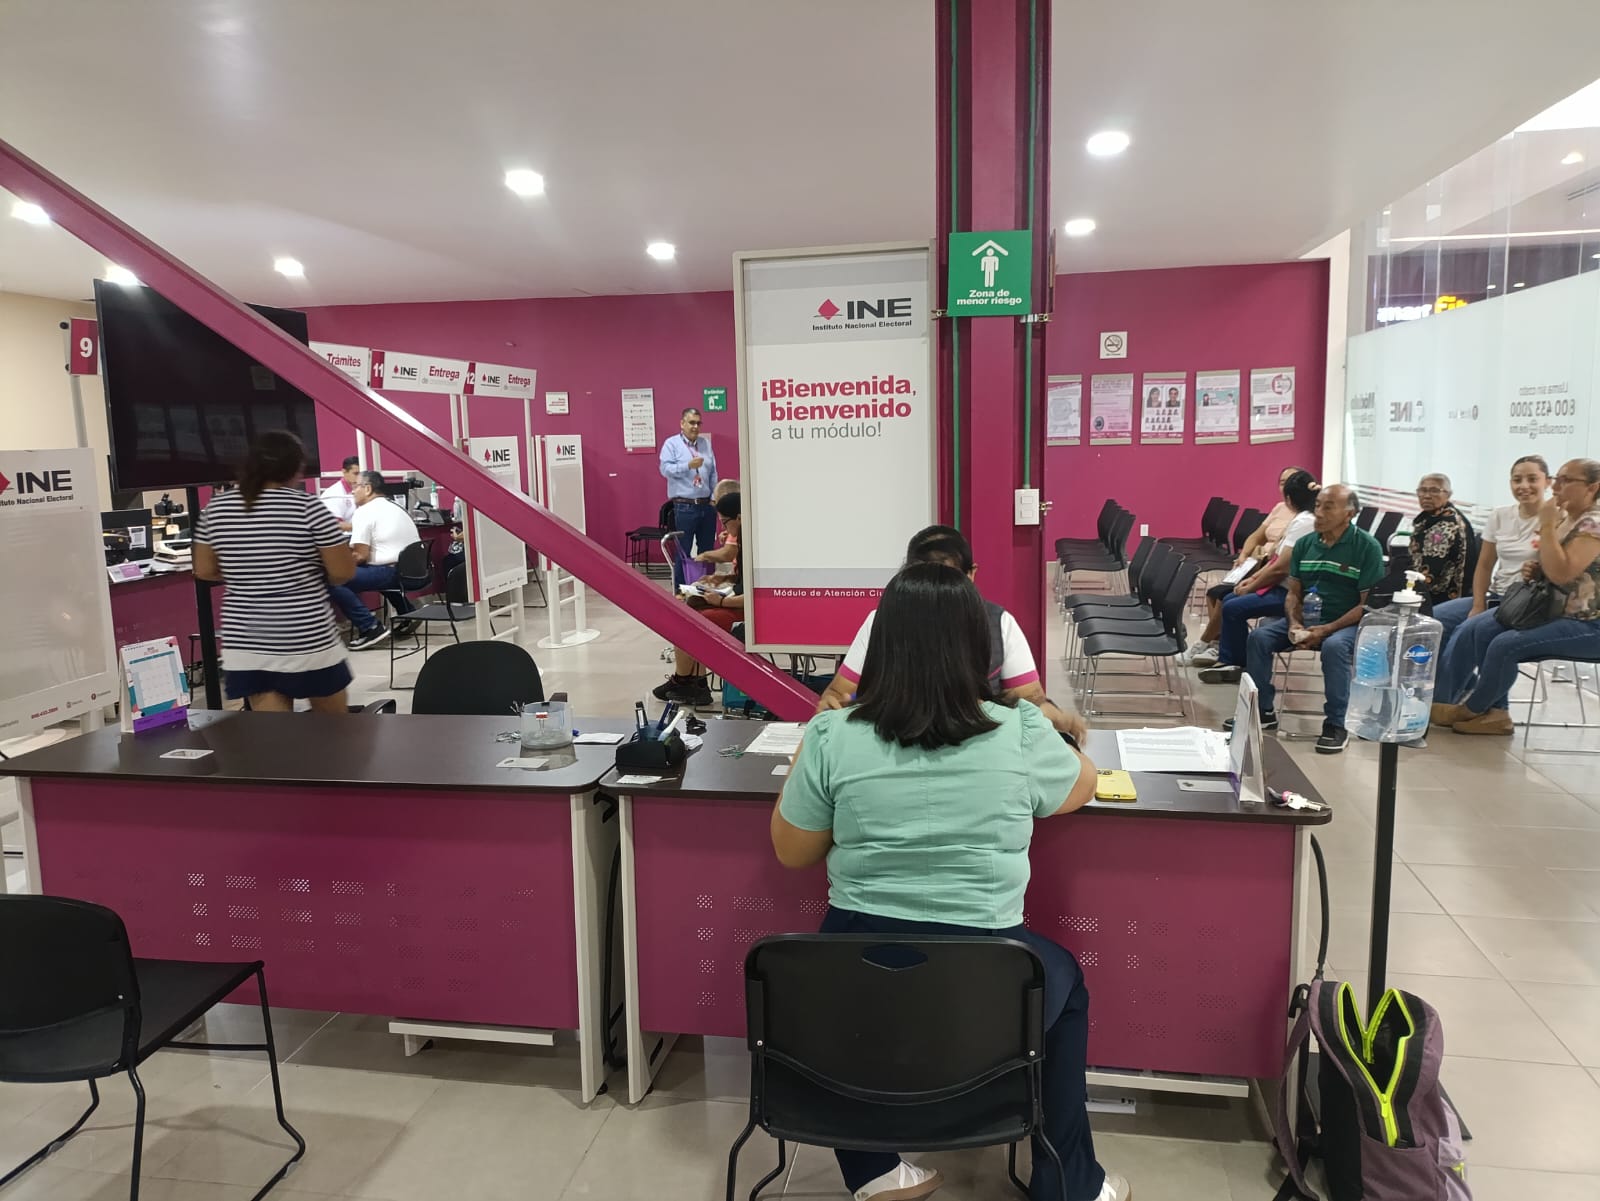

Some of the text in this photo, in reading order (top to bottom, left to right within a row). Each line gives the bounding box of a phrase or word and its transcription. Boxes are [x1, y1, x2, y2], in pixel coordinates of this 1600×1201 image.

[969, 289, 1010, 298] Zona de
[991, 297, 1022, 305] riesgo
[847, 298, 912, 320] INE
[879, 320, 912, 328] Electoral
[80, 337, 93, 358] 9
[327, 353, 362, 367] Trámites
[372, 362, 384, 378] 11
[400, 366, 418, 377] INE
[429, 366, 460, 381] Entrega
[466, 372, 476, 385] 12
[487, 376, 500, 384] INE
[508, 374, 531, 387] Entrega
[761, 375, 917, 401] ¡Bienvenida,
[770, 398, 912, 421] bienvenido
[771, 421, 881, 440] a tu módulo!
[492, 449, 510, 462] INE
[562, 445, 576, 456] INE
[16, 470, 72, 494] INE
[16, 496, 45, 505] Nacional
[46, 494, 73, 502] Electoral
[773, 589, 807, 597] Módulo
[810, 589, 821, 597] de
[824, 589, 866, 597] Atención
